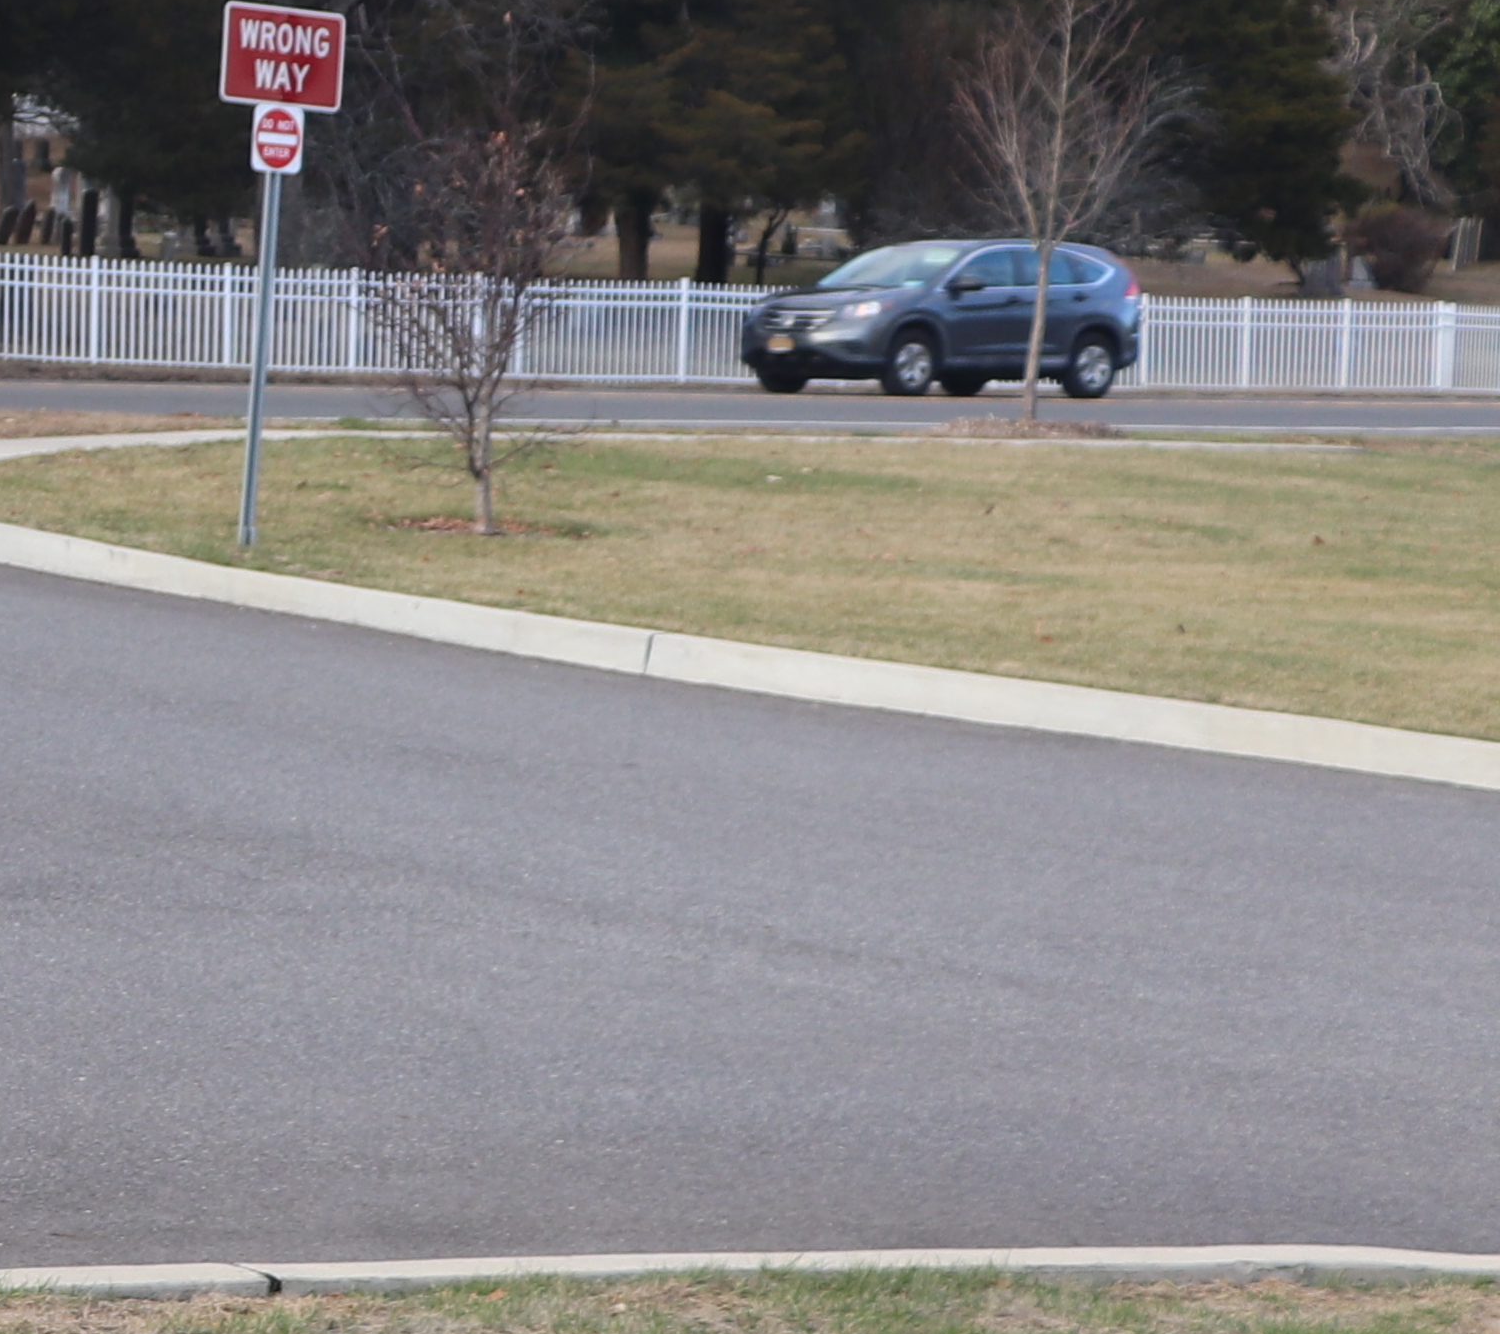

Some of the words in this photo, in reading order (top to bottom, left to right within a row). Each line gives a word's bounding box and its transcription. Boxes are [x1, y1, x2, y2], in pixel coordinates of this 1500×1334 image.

[239, 17, 331, 59] WRONG
[254, 58, 311, 93] WAY
[261, 118, 275, 129] DO
[277, 119, 295, 131] NOT
[263, 145, 291, 158] ENTER
